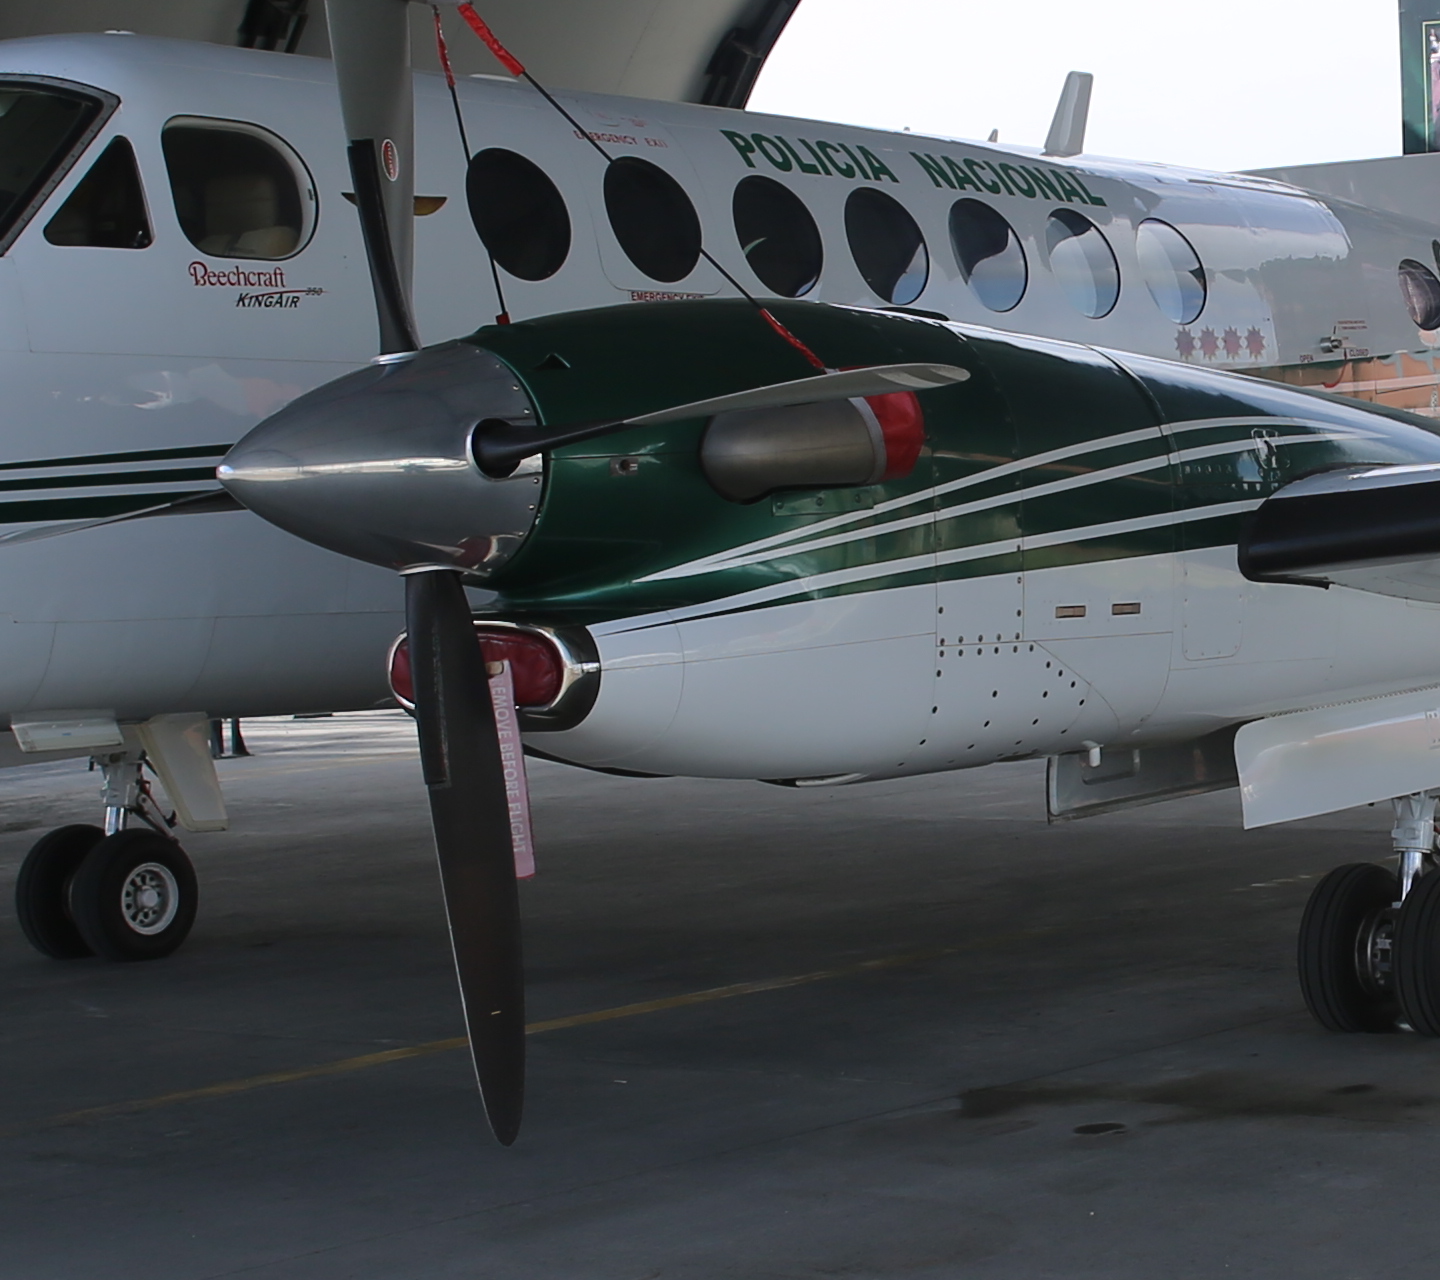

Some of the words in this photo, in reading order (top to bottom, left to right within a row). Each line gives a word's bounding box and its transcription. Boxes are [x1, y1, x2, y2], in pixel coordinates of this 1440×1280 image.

[720, 129, 900, 184] POLICIA
[908, 151, 1108, 207] NACIONAL
[188, 261, 287, 288] Beechcraft
[499, 743, 520, 798] BEFORE
[508, 802, 527, 853] FLIGHT
